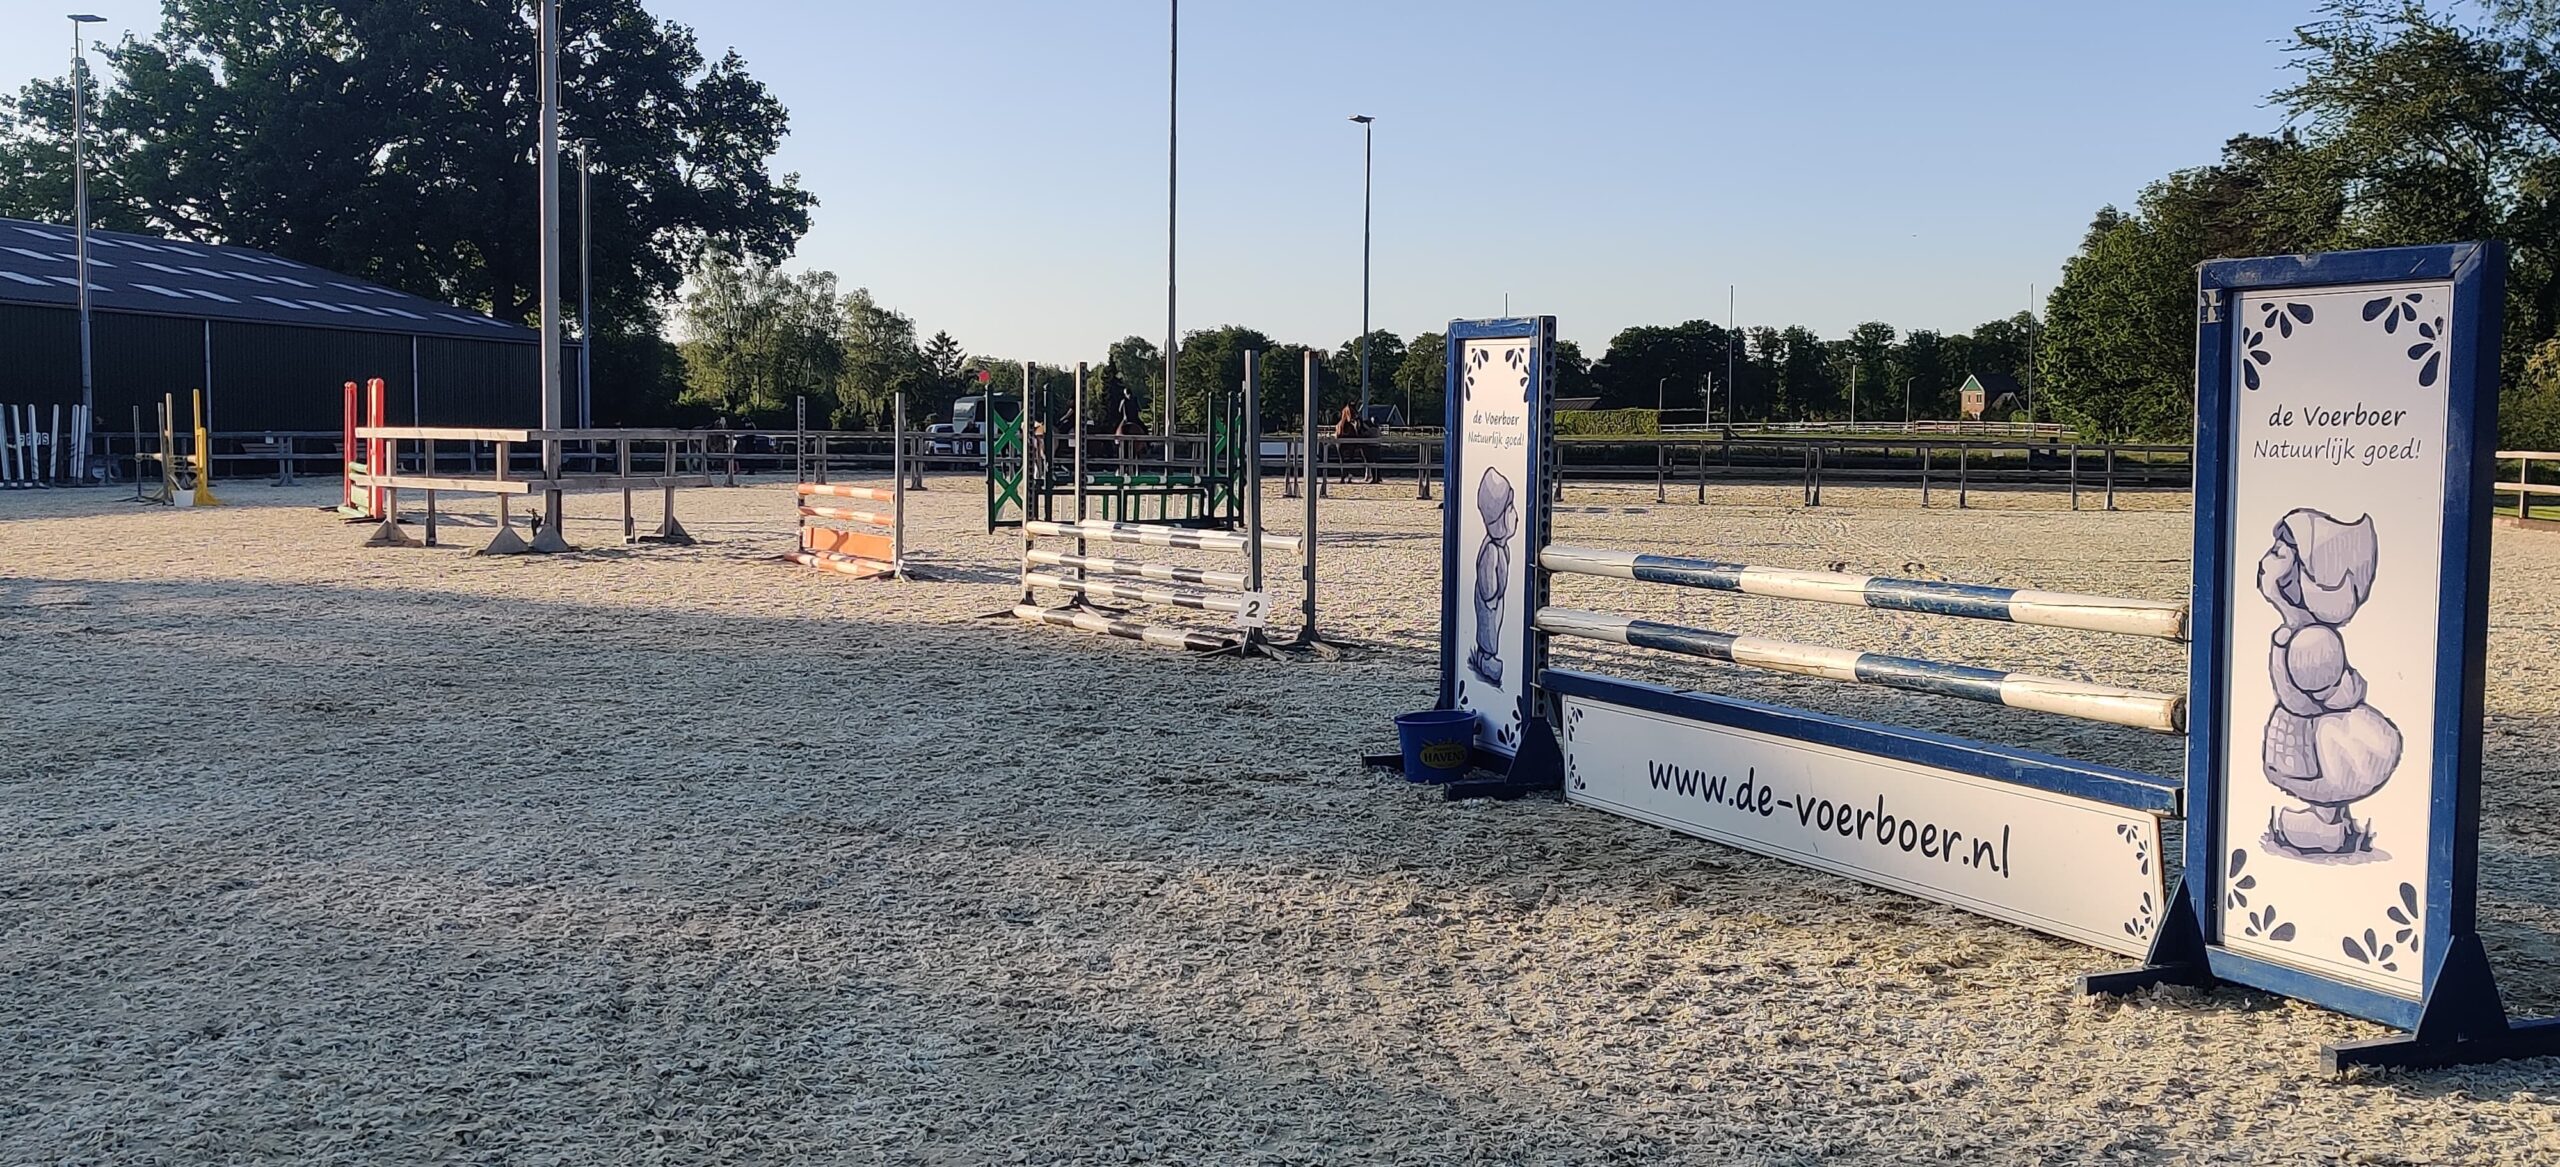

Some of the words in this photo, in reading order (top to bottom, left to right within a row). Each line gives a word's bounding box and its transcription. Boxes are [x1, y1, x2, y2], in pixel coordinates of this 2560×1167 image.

[1473, 410, 1482, 424] de
[1485, 410, 1519, 425] Voerboer
[2269, 403, 2294, 426] de
[2304, 402, 2407, 426] Voerboer
[1468, 431, 1502, 448] Natuurlijk
[1504, 432, 1524, 449] goed!
[2254, 438, 2355, 465] Natuurlijk
[2362, 437, 2421, 466] goed!
[1245, 600, 1260, 618] 2
[1649, 760, 2010, 878] www.de-voerboer.nl
